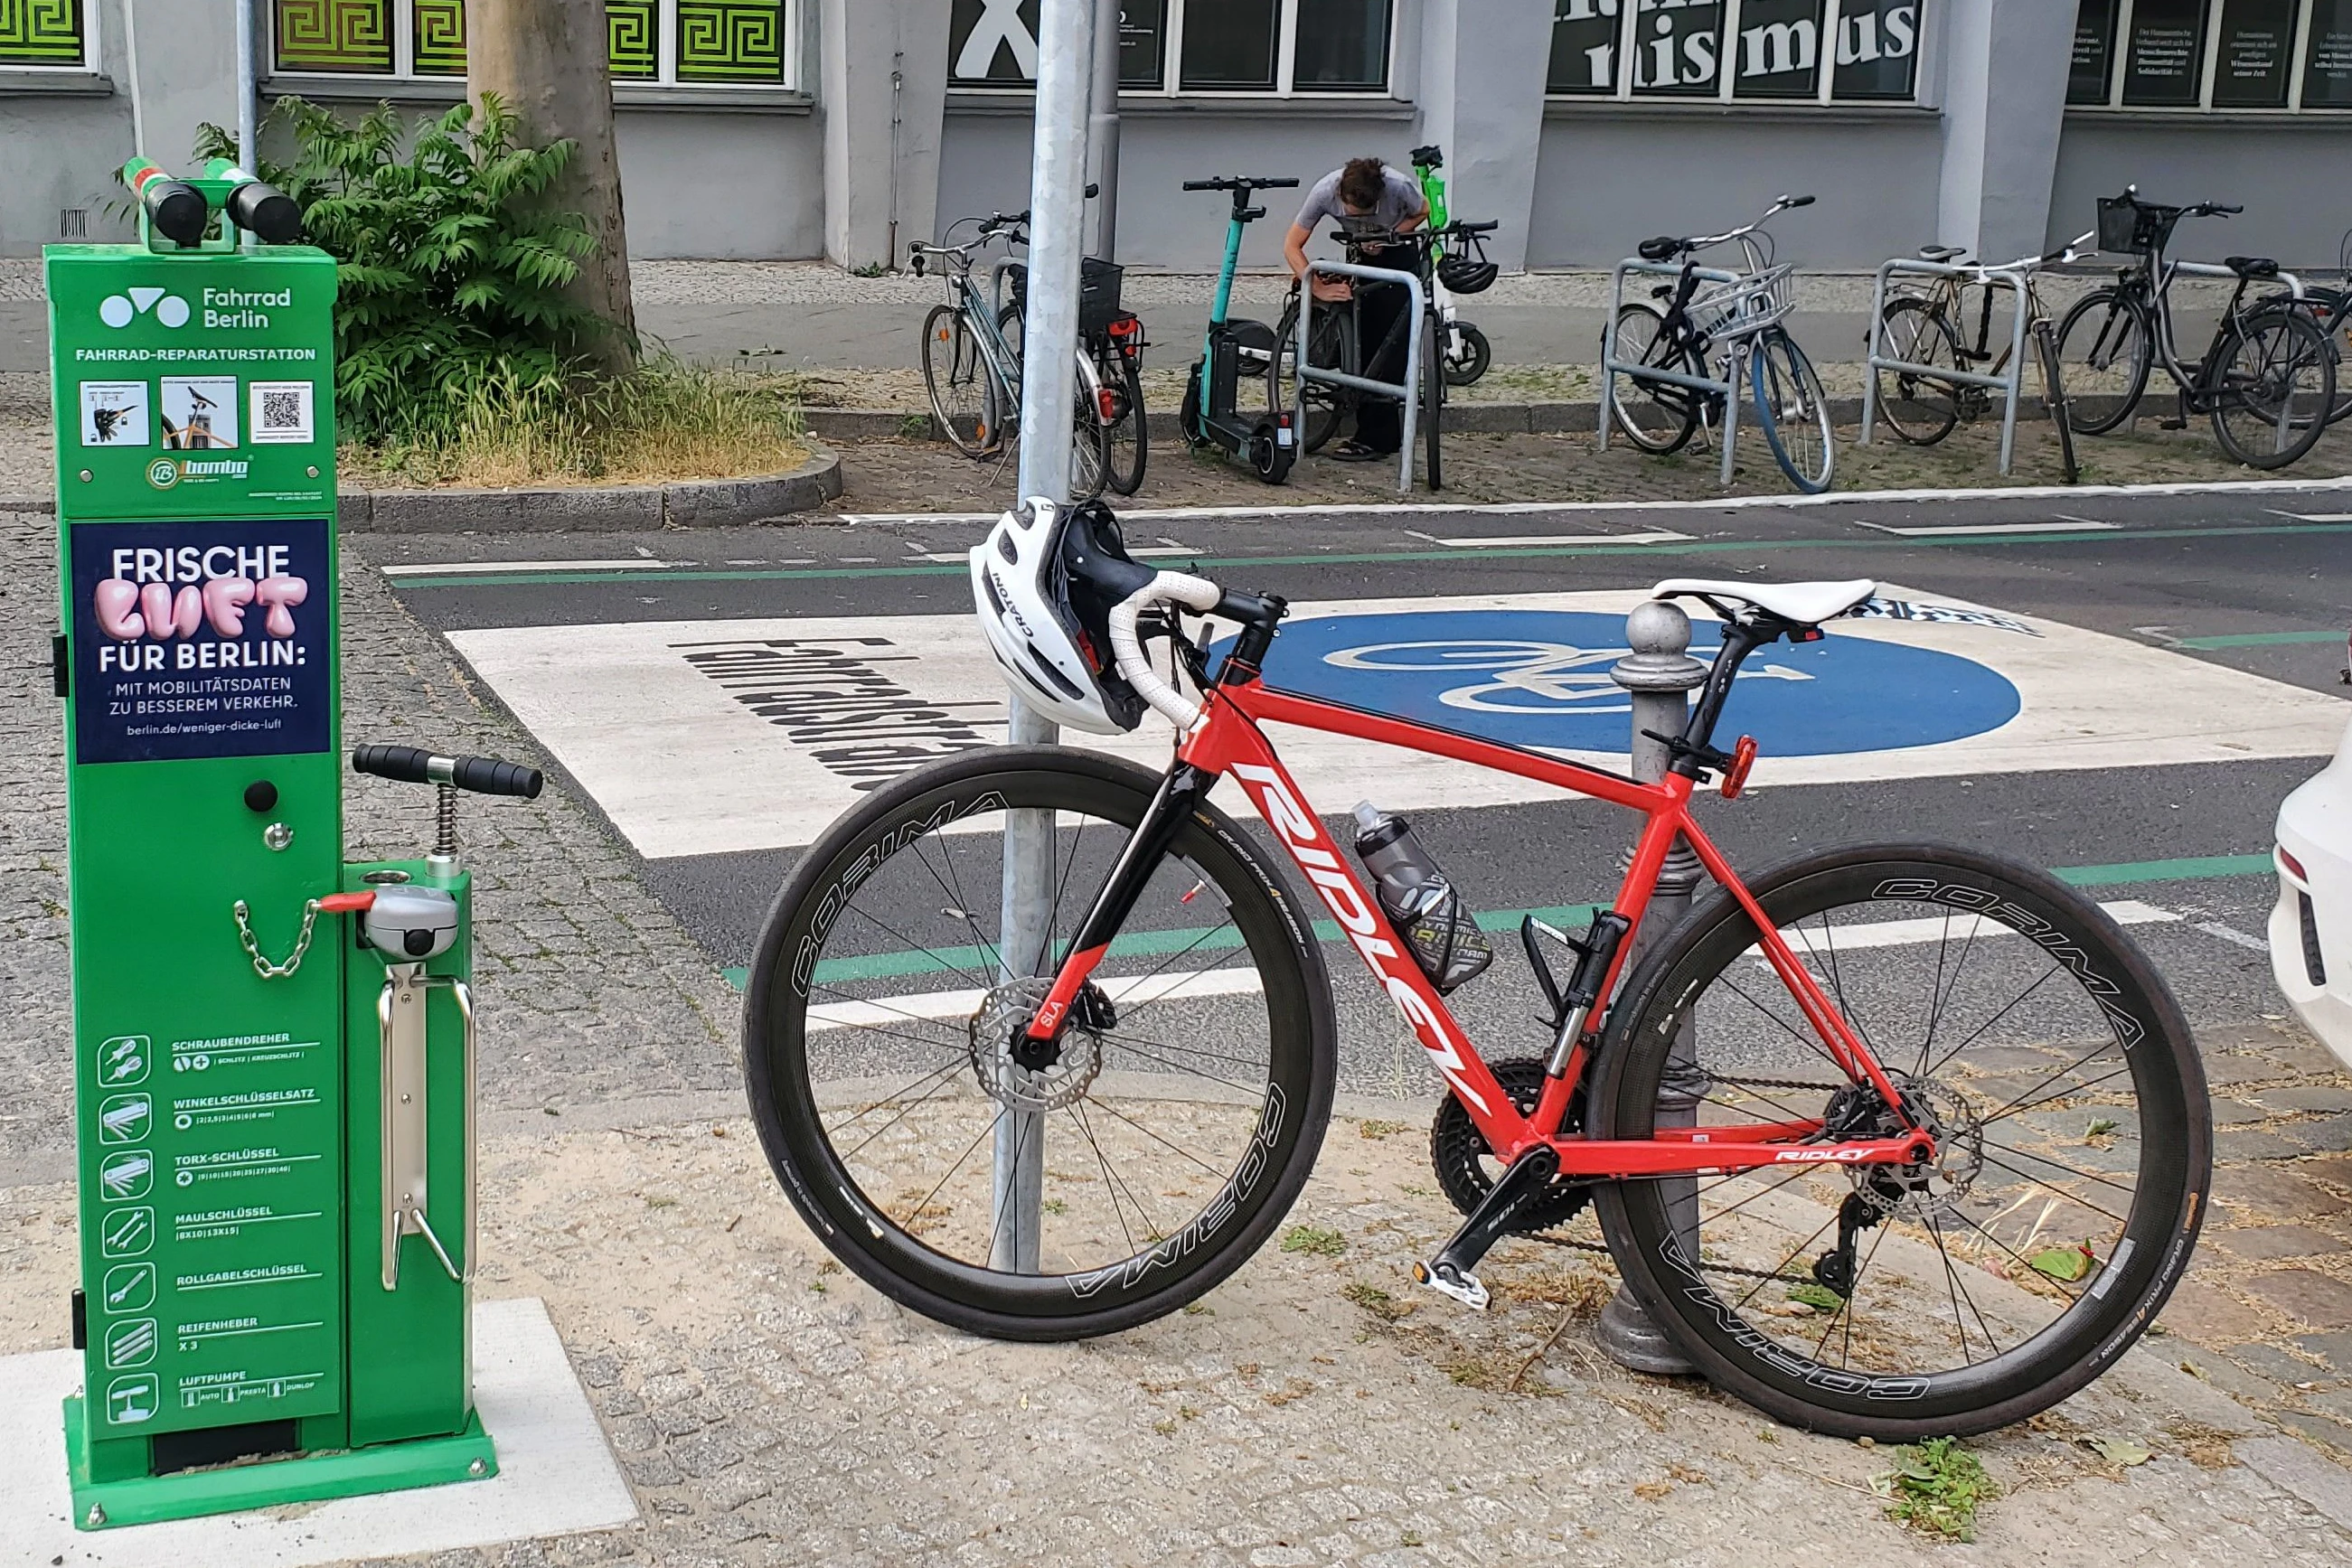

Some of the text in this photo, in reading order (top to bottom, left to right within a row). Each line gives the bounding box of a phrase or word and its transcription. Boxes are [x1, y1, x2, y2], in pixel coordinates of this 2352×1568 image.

[203, 287, 291, 307] Fahrrad
[203, 309, 269, 328] Berlin
[76, 348, 316, 361] FAHRRAD-REPARATURSTATION
[113, 545, 290, 583] FRISCHE
[94, 576, 308, 641] LUFT
[992, 572, 1034, 638] CRATONI
[99, 638, 306, 672] FÜR BERLIN:
[116, 676, 291, 697] MIT MOBILITÄTSDATEN
[109, 695, 298, 715] ZU BESSEREM VERKEHR.
[666, 636, 1011, 792] Fahrradstra
[127, 718, 281, 736] berlin.de/weniger-dicke-luft
[1218, 830, 1253, 862] GRAND
[1250, 861, 1275, 888] PRIX
[792, 790, 1011, 997] CORIMA
[1230, 761, 1492, 1118] RIDLEY
[1871, 878, 2146, 1051] CORIMA
[1040, 1000, 1064, 1028] SLA
[172, 1033, 290, 1051] SCHRAUBENDREHER
[174, 1088, 315, 1110] WINKELSCHLÜSSELSATZ
[174, 1147, 280, 1166] TORX-SCHLÜSSEL
[1775, 1148, 1875, 1162] RIDLEY
[1064, 1082, 1286, 1299] CORIMA
[175, 1207, 273, 1225] MAULSCHLÜSSEL
[176, 1263, 307, 1286] ROLLGABELSCHLÜSSEL
[1659, 1229, 1932, 1400] CORIMA
[178, 1317, 259, 1334] REIFENHEBER
[179, 1342, 198, 1351] X 3
[179, 1371, 247, 1386] LUFTPUMPE
[201, 1392, 220, 1400] AUTO
[240, 1387, 267, 1396] PRESTA
